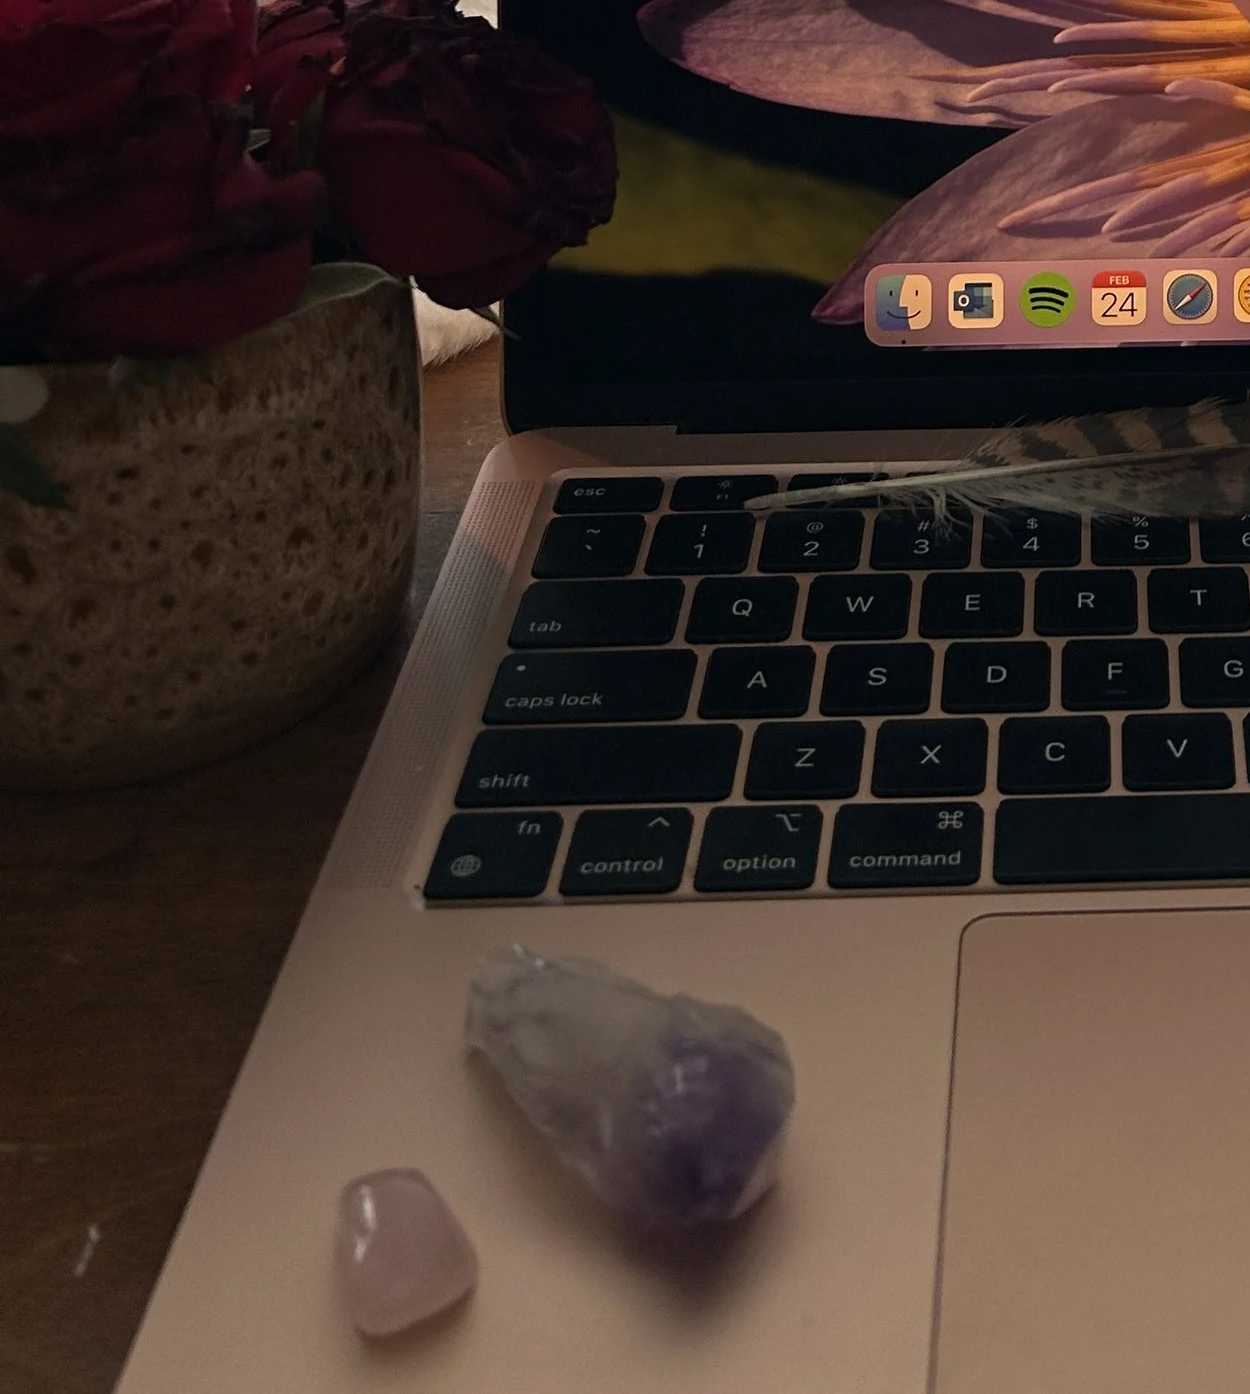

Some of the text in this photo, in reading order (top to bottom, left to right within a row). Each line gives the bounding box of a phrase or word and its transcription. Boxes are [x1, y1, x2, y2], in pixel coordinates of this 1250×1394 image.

[1109, 275, 1130, 285] FEB
[1100, 292, 1138, 317] 24
[574, 487, 606, 497] esc
[803, 541, 819, 556] 2
[913, 539, 930, 554] 3
[1023, 536, 1040, 551] 4
[1133, 535, 1150, 550] 5
[694, 544, 704, 558] 1
[846, 596, 874, 612] W
[965, 594, 981, 610] E
[1078, 592, 1095, 608] R
[1190, 589, 1207, 605] T
[732, 599, 753, 617] Q
[530, 620, 561, 632] tab
[868, 667, 887, 686] S
[986, 665, 1007, 683] D
[1108, 662, 1124, 680] F
[1223, 660, 1244, 678] G
[747, 671, 767, 688] A
[505, 693, 603, 709] caps lock
[920, 745, 942, 764] X
[1045, 742, 1066, 761] C
[1166, 739, 1188, 758] V
[794, 748, 816, 767] Z
[478, 774, 530, 789] shift
[518, 821, 541, 835] fn
[580, 857, 664, 874] control
[722, 856, 796, 874] option
[849, 851, 961, 867] command
